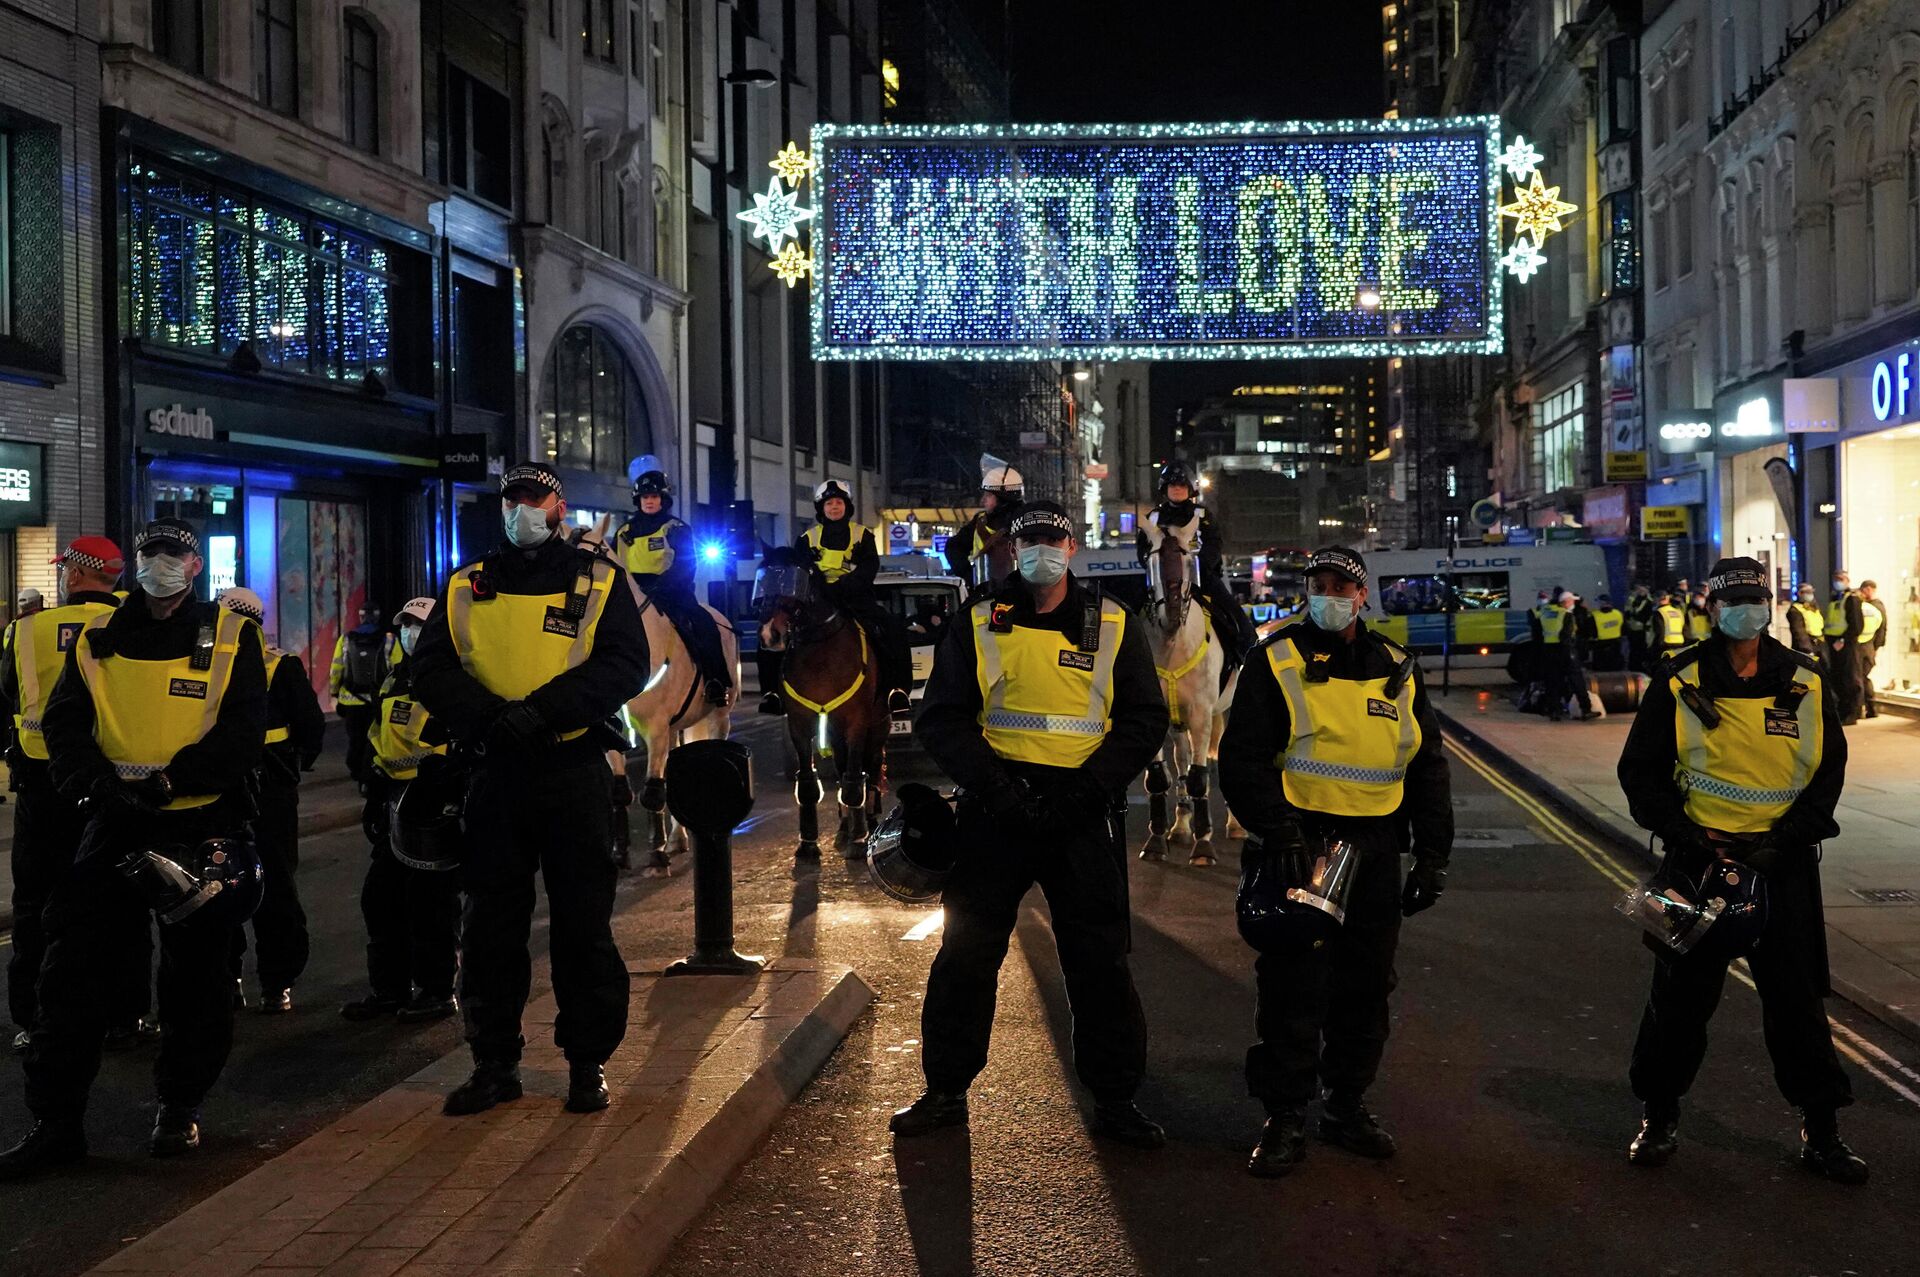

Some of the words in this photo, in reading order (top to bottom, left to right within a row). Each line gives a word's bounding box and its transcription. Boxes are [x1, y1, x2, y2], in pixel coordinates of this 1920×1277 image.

[1176, 172, 1439, 314] LOVE
[1872, 351, 1920, 421] OF
[149, 404, 214, 439] schuh
[445, 452, 480, 463] schuh
[1435, 557, 1523, 568] POLICE
